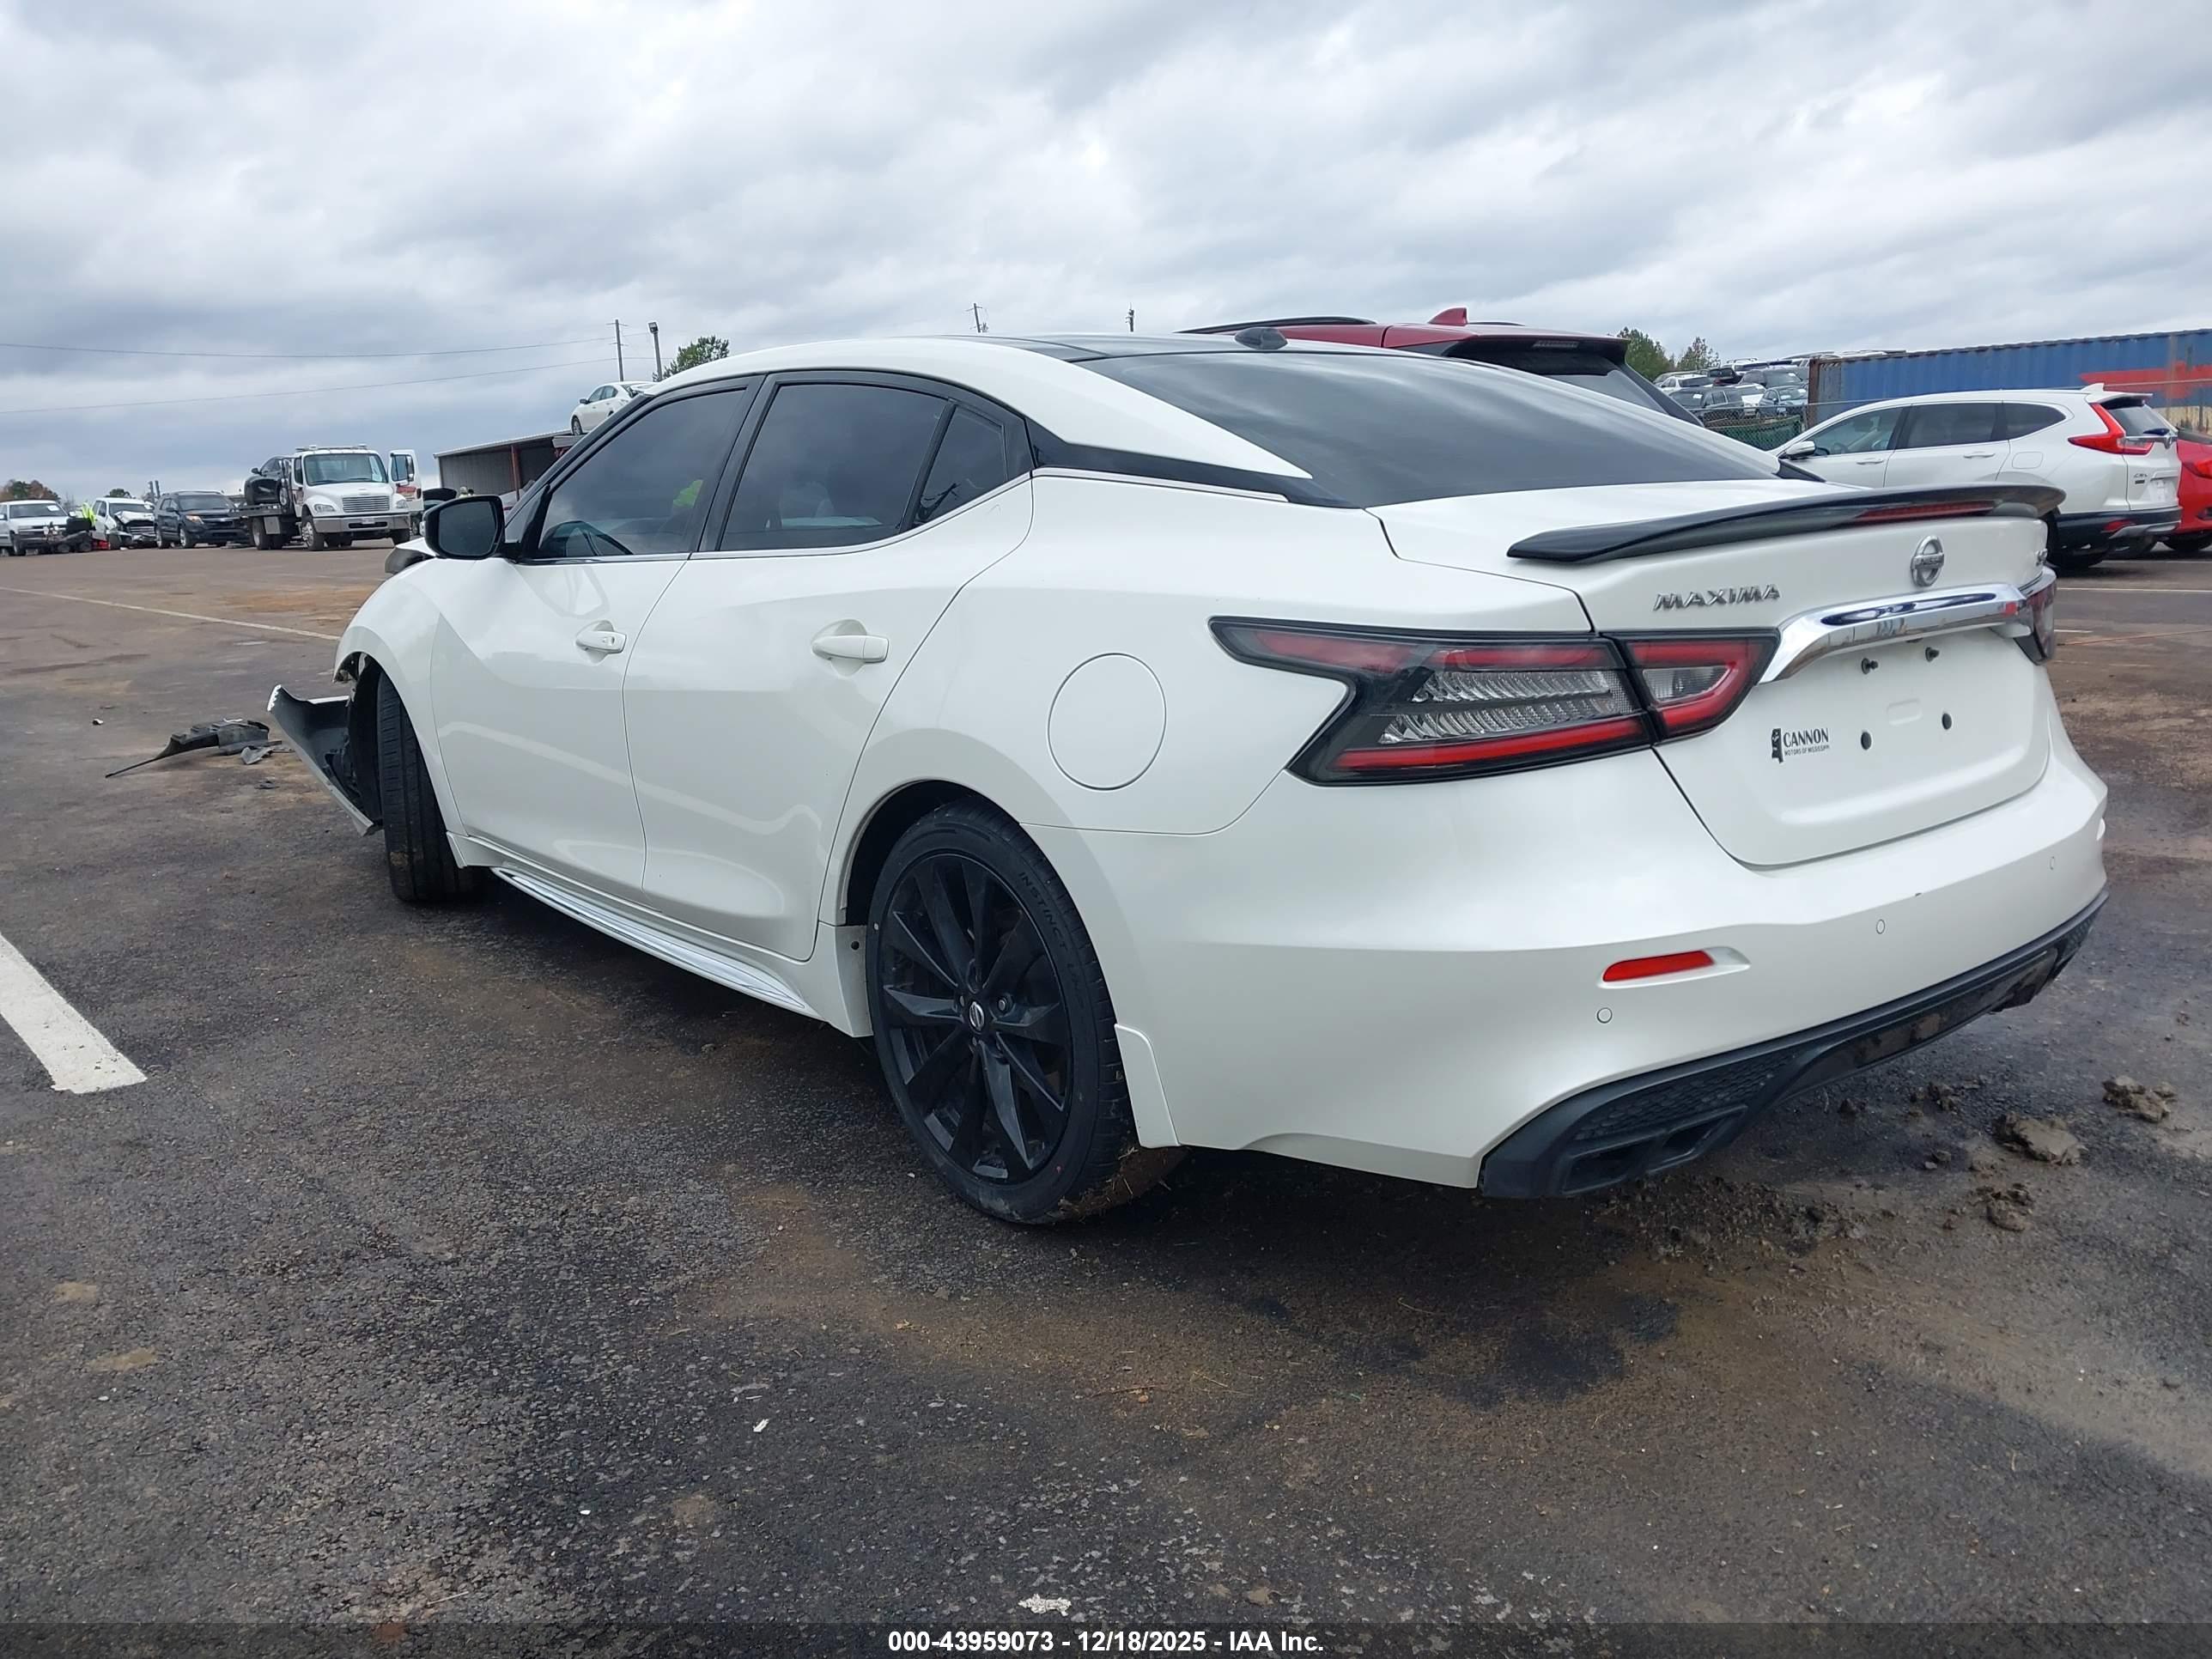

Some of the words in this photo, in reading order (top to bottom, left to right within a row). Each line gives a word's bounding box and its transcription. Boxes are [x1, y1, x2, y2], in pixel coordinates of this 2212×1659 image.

[1653, 584, 1780, 611] MAXIMA
[1784, 728, 1828, 747] CANNON
[1018, 872, 1067, 951] INSTINCT
